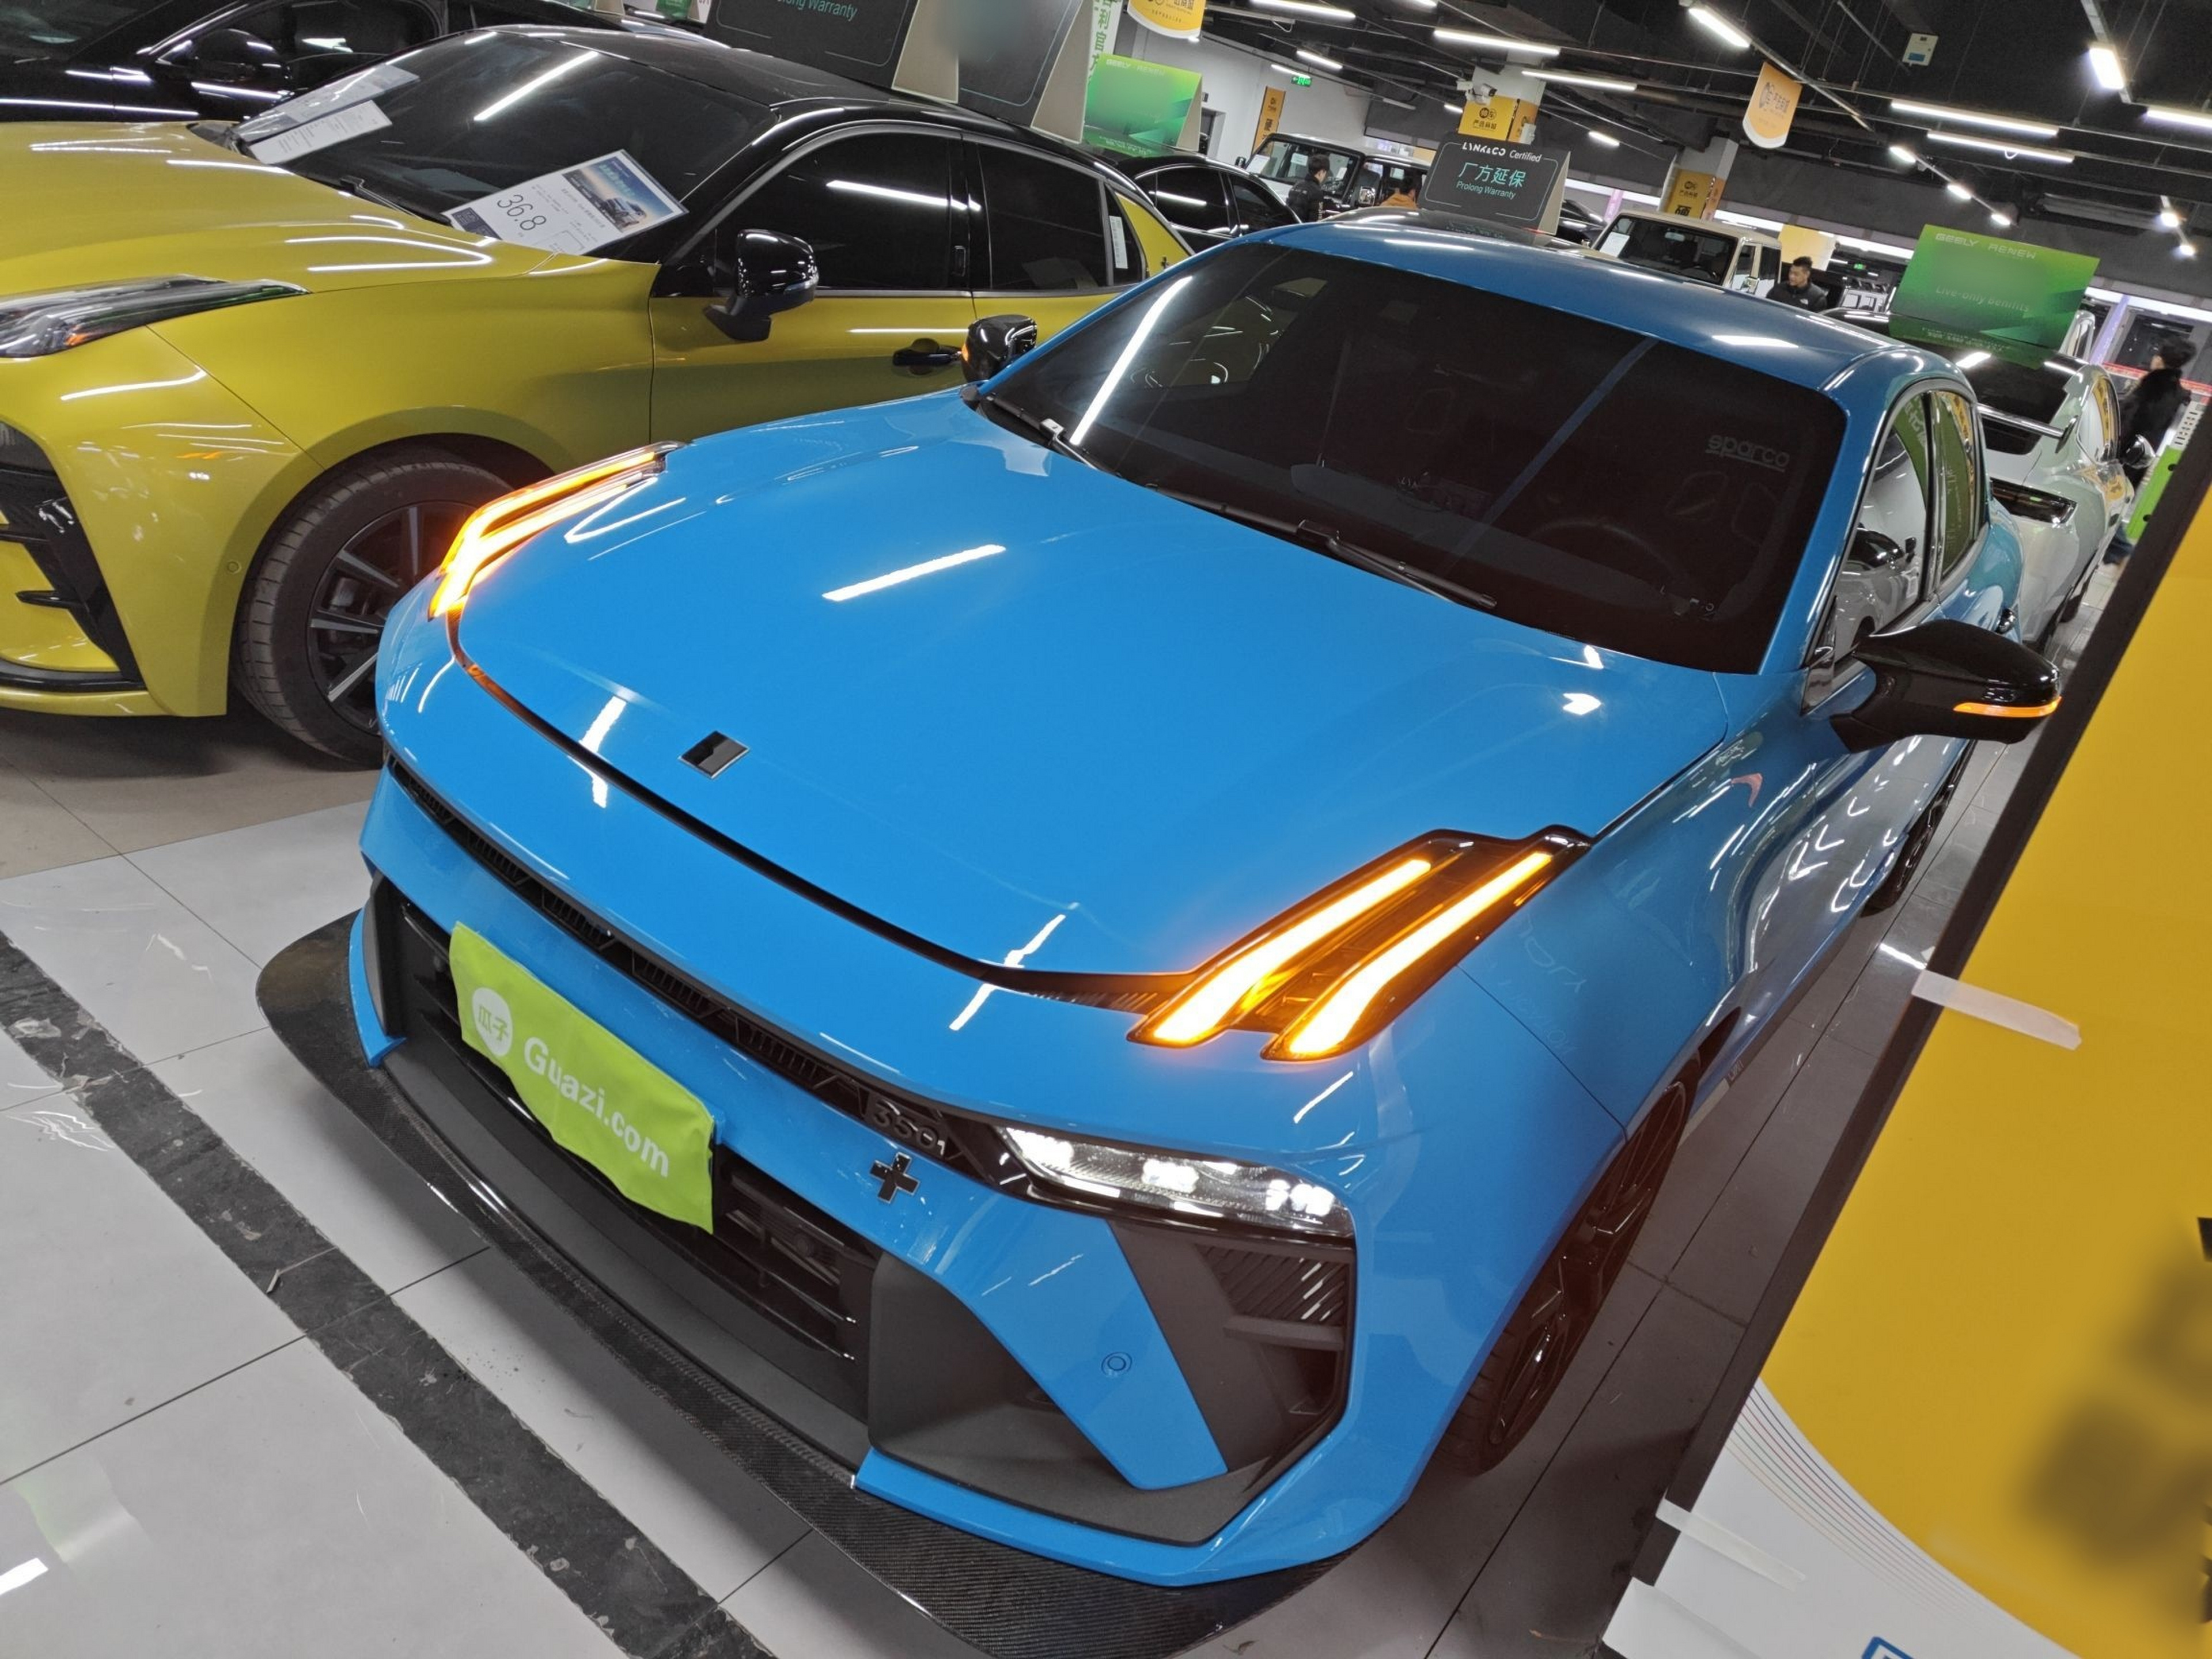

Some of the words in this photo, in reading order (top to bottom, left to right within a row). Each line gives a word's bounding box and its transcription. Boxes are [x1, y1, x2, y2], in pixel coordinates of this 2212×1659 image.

[808, 0, 858, 21] Warranty
[1509, 150, 1542, 162] Certified
[1458, 162, 1527, 188] 厂方延保
[1456, 181, 1483, 194] Prolong
[1484, 187, 1516, 200] Warranty
[497, 194, 547, 231] 36.8
[1935, 233, 1980, 247] GEELY
[1988, 243, 2037, 259] RENEW
[1707, 434, 1790, 468] sparco
[478, 1003, 509, 1041] 瓜子
[524, 1036, 669, 1178] Guazi.com
